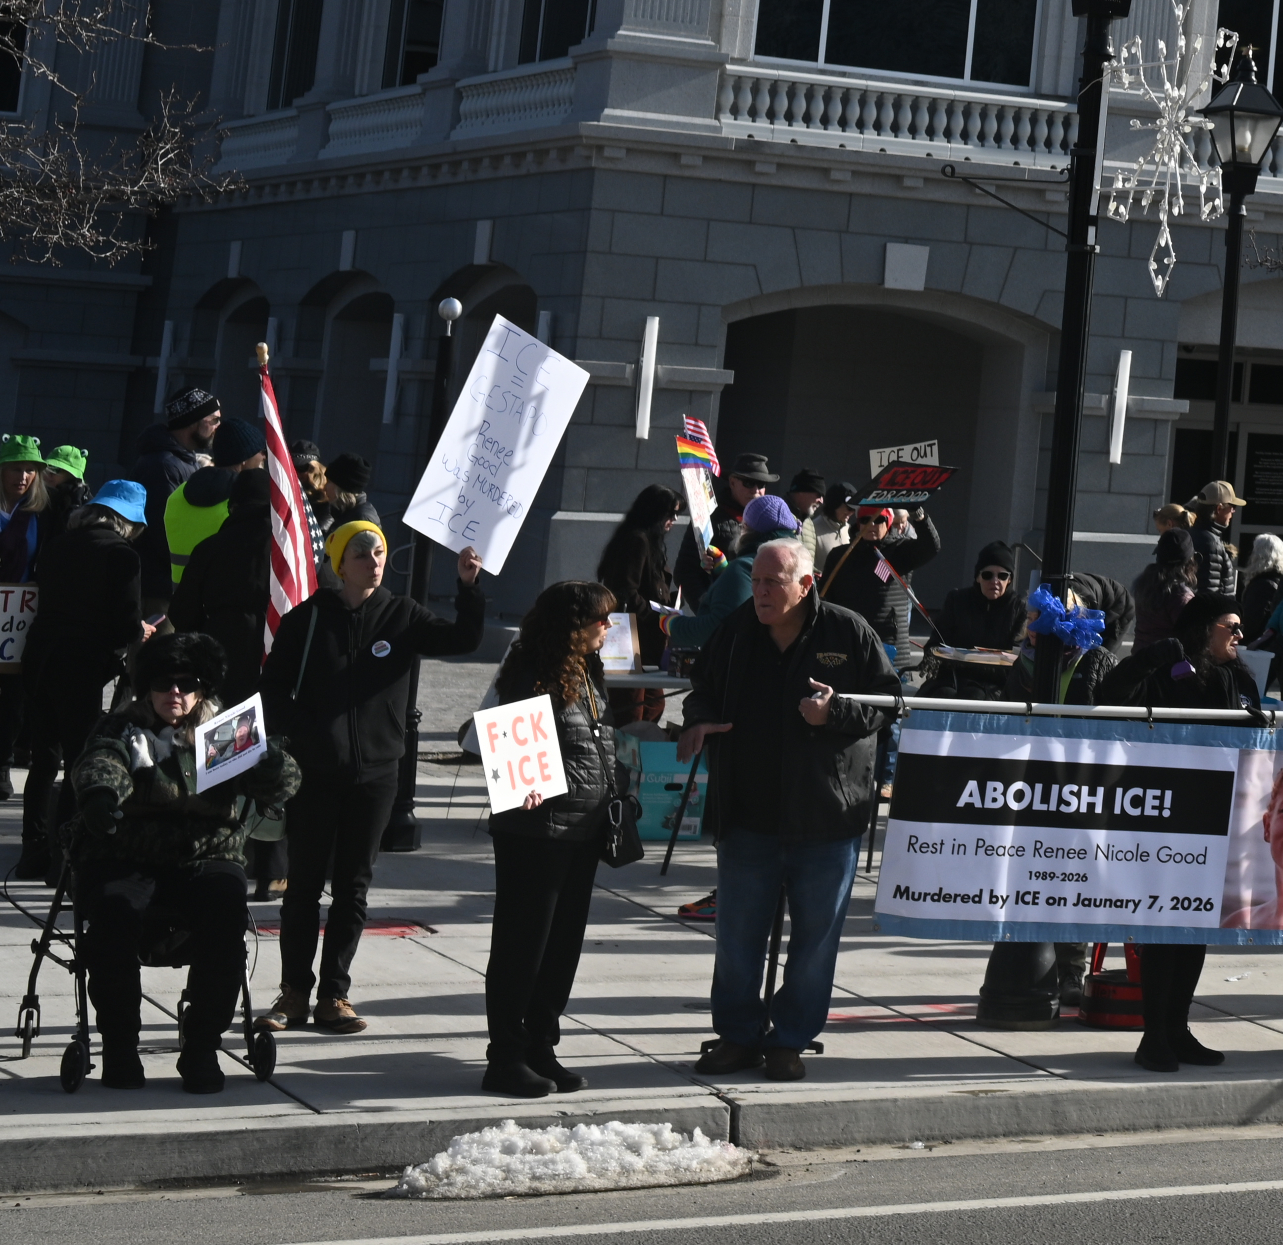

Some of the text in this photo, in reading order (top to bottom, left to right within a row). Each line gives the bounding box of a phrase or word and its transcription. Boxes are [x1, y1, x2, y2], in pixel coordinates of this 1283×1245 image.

[486, 323, 561, 391] ICE
[470, 375, 548, 437] GESTAPO
[475, 419, 514, 466] Renee
[910, 442, 936, 462] OUT
[466, 444, 503, 478] Good
[457, 486, 475, 515] by
[472, 474, 524, 519] MURDERED
[867, 490, 929, 502] FOR GOOD
[428, 500, 480, 541] ICE
[1, 616, 26, 632] do
[507, 751, 552, 791] ICE
[956, 780, 1173, 818] ABOLISH ICE!
[906, 835, 1208, 865] Rest in Peace Renee Nicole Good
[1027, 870, 1088, 882] 1989-2026
[892, 885, 1214, 913] Murdered by ICE on Jaunary 7, 2026
